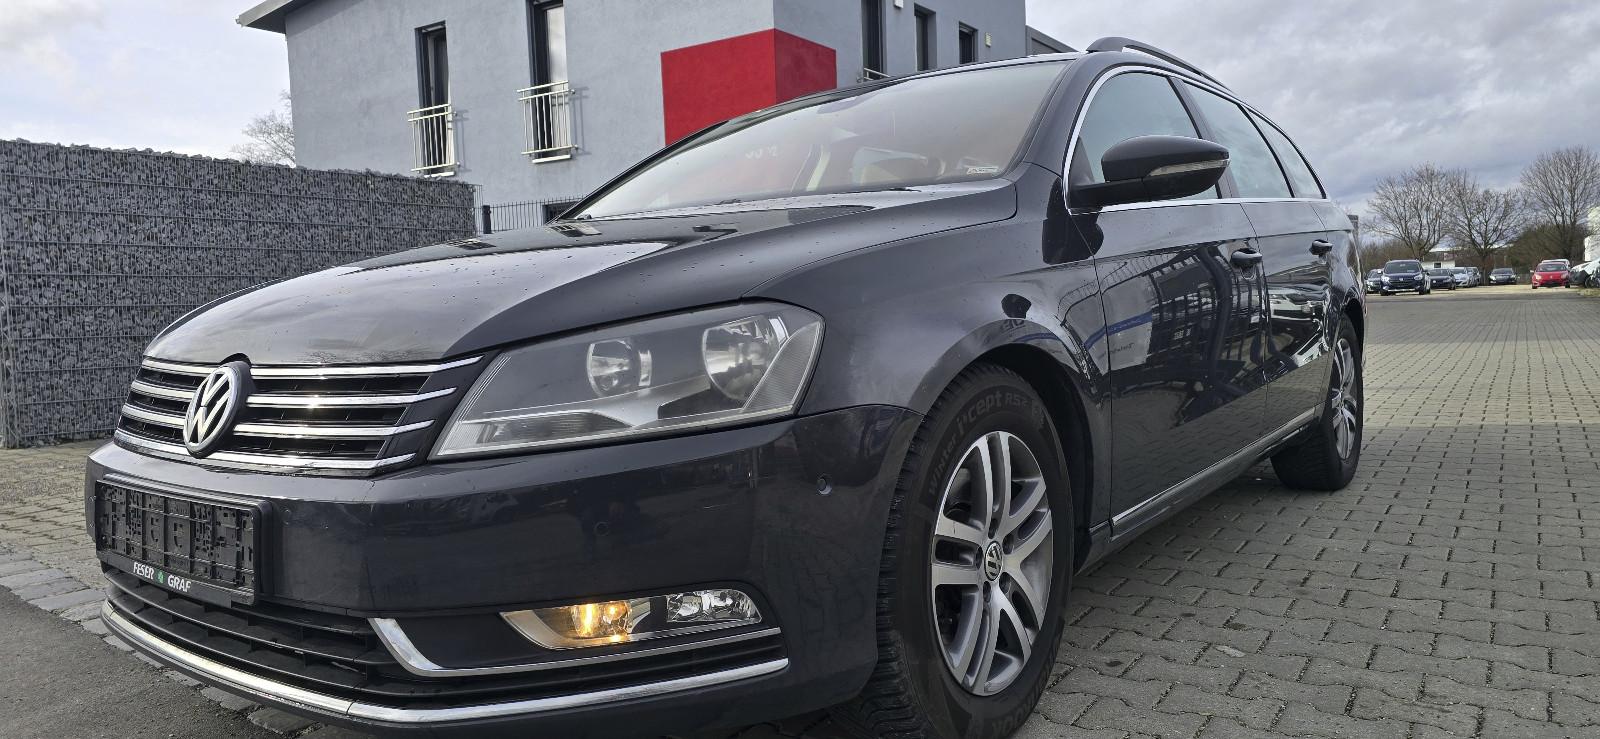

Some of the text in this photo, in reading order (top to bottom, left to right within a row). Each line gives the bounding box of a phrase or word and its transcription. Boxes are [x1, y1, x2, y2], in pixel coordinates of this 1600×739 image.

[185, 368, 236, 450] VW
[133, 561, 192, 593] FESER GRAF
